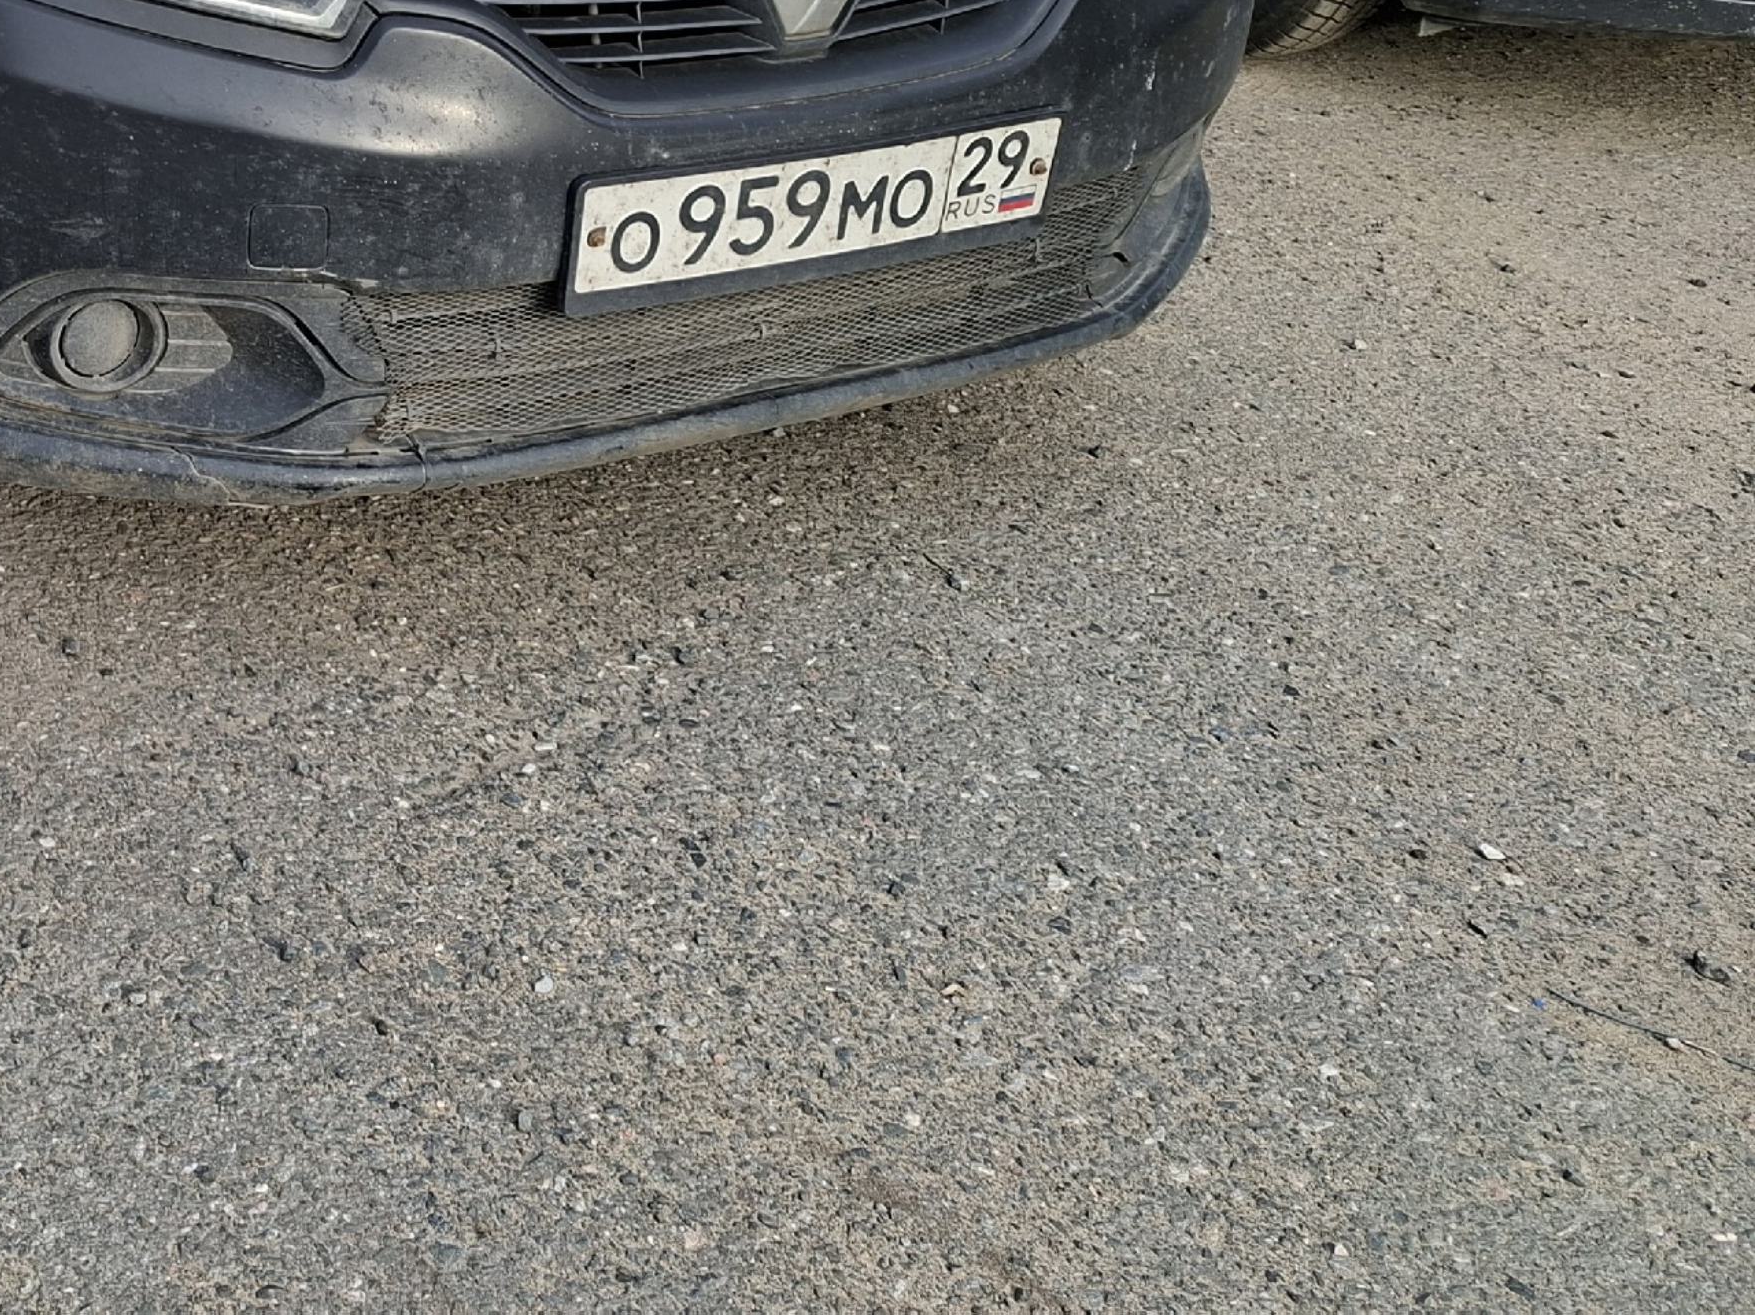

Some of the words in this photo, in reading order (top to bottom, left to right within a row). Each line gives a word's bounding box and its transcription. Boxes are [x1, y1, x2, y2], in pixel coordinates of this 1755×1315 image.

[610, 169, 933, 273] О959МО
[957, 130, 1030, 197] 29
[945, 194, 997, 222] RUS
